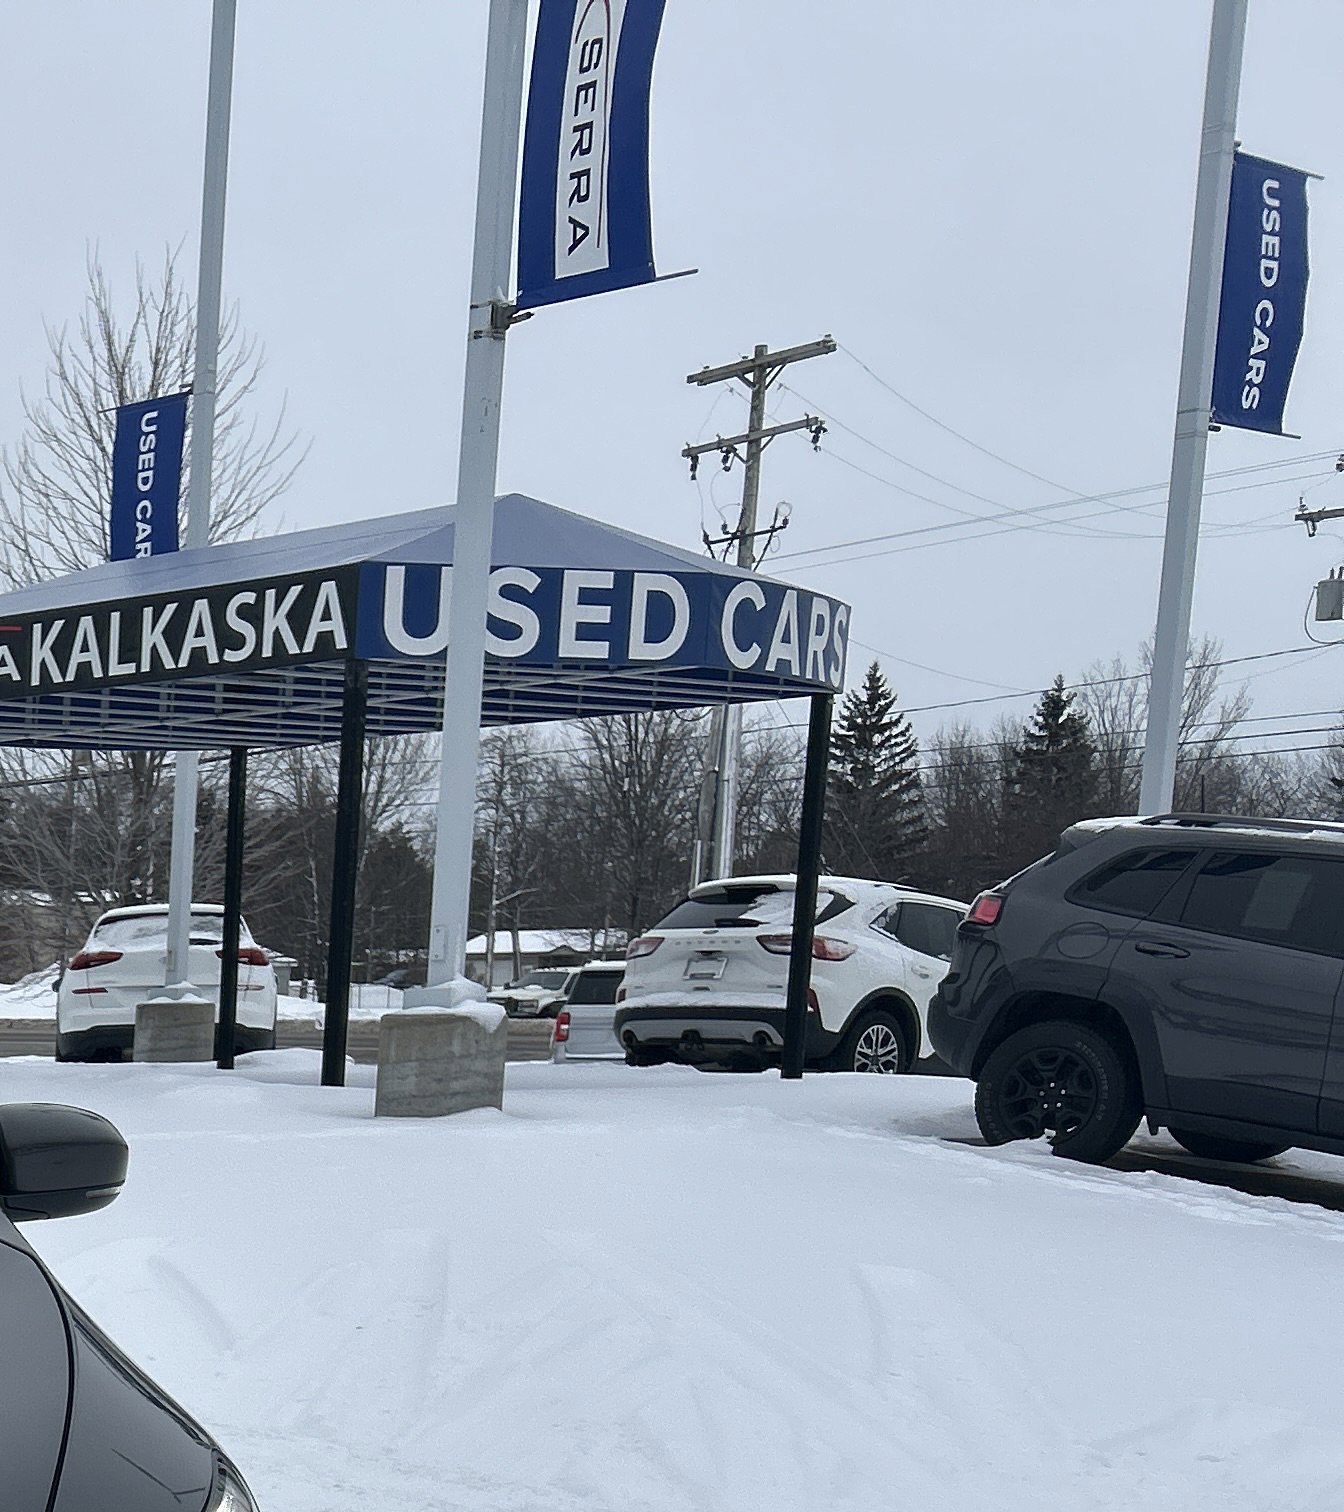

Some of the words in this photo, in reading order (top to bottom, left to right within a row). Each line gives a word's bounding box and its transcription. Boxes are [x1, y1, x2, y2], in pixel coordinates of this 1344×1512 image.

[567, 37, 604, 257] SERRA
[1259, 178, 1281, 289] USED
[1241, 298, 1276, 412] CARS
[136, 410, 160, 492] USED
[134, 499, 153, 559] CAR
[28, 580, 349, 687] KALKASKA
[382, 565, 691, 660] USED
[720, 580, 848, 687] CARS
